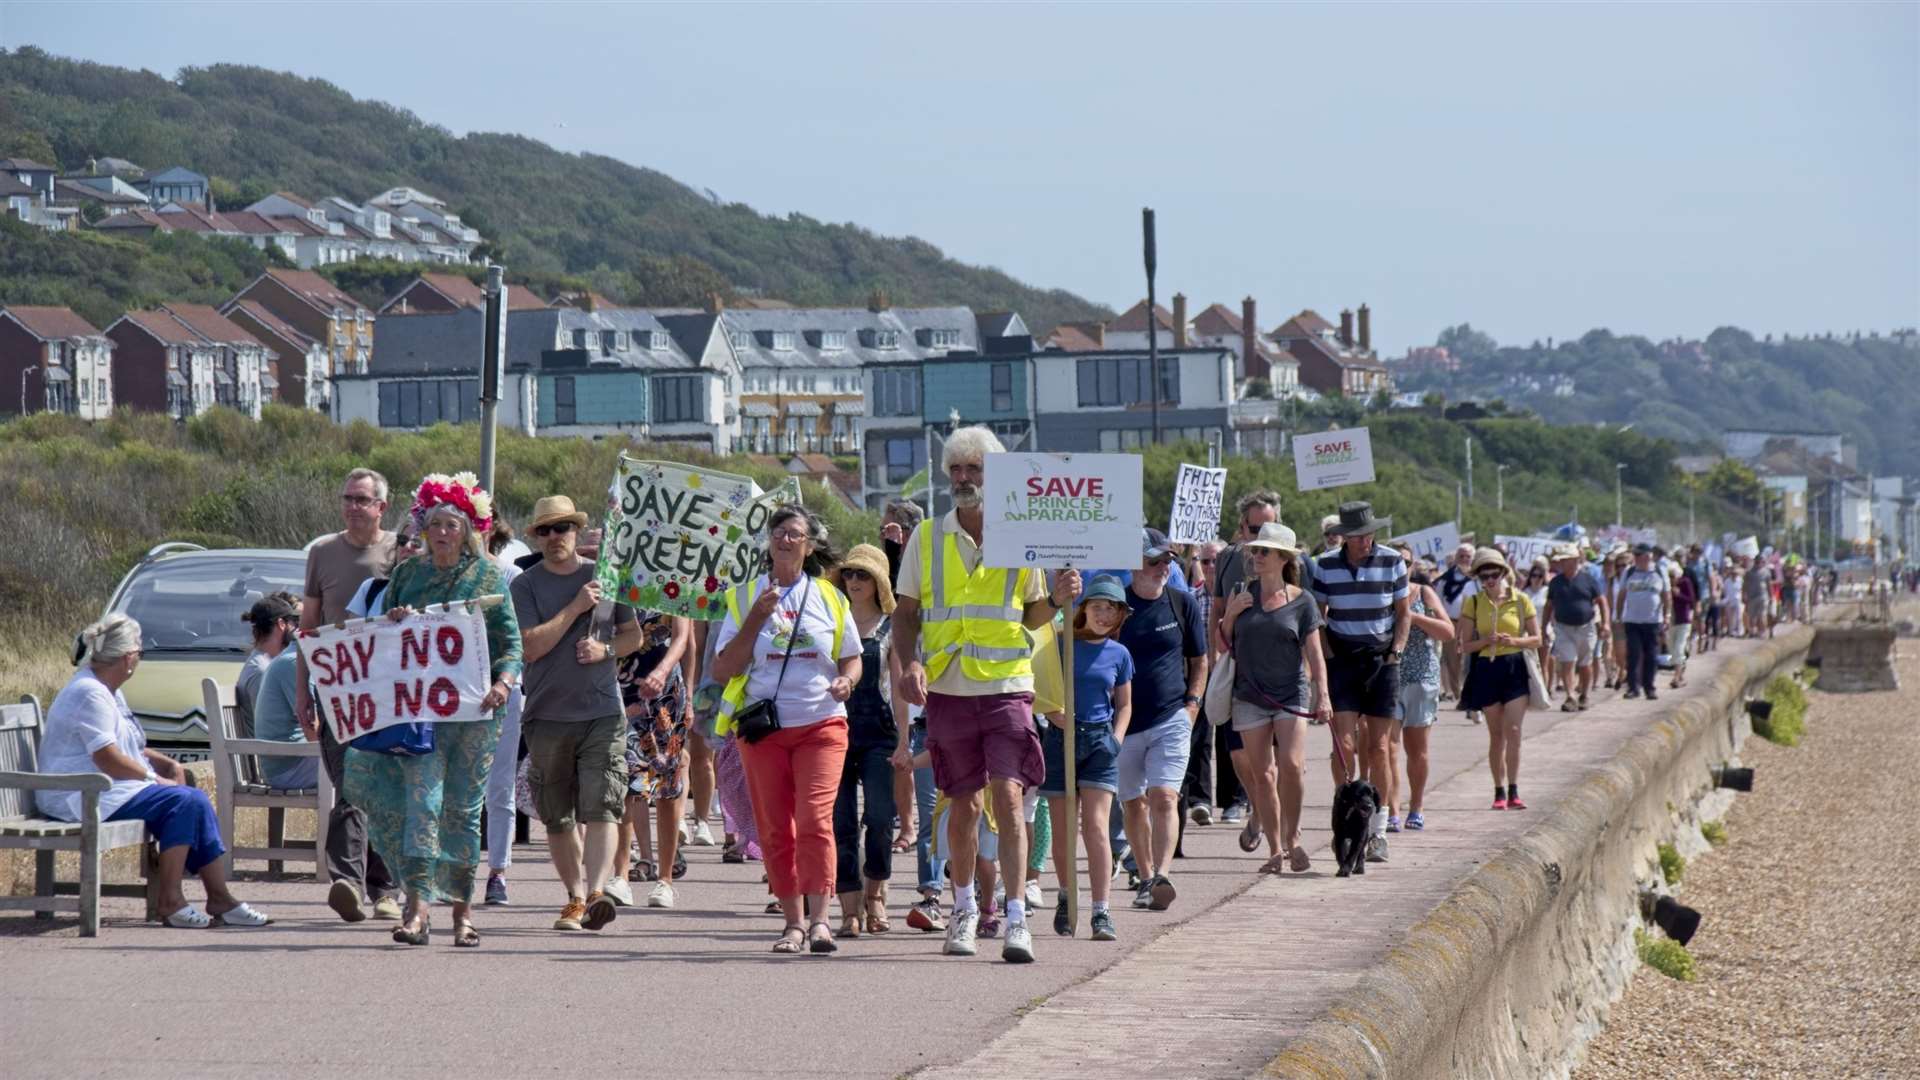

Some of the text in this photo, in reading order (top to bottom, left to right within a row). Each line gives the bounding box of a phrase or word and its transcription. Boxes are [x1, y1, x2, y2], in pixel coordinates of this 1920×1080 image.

[1313, 440, 1352, 455] SAVE
[1182, 467, 1222, 487] FHDC
[1026, 477, 1104, 498] SAVE
[1178, 486, 1221, 505] LISTEN
[621, 475, 714, 530] SAVE
[1027, 496, 1104, 509] PRINCE'S
[1178, 503, 1193, 517] TO
[1027, 509, 1104, 521] PARADE
[1175, 518, 1195, 540] YOU
[611, 520, 725, 584] GREEN
[310, 634, 376, 686] SAY
[400, 625, 464, 670] NO
[331, 676, 460, 740] NO NO
